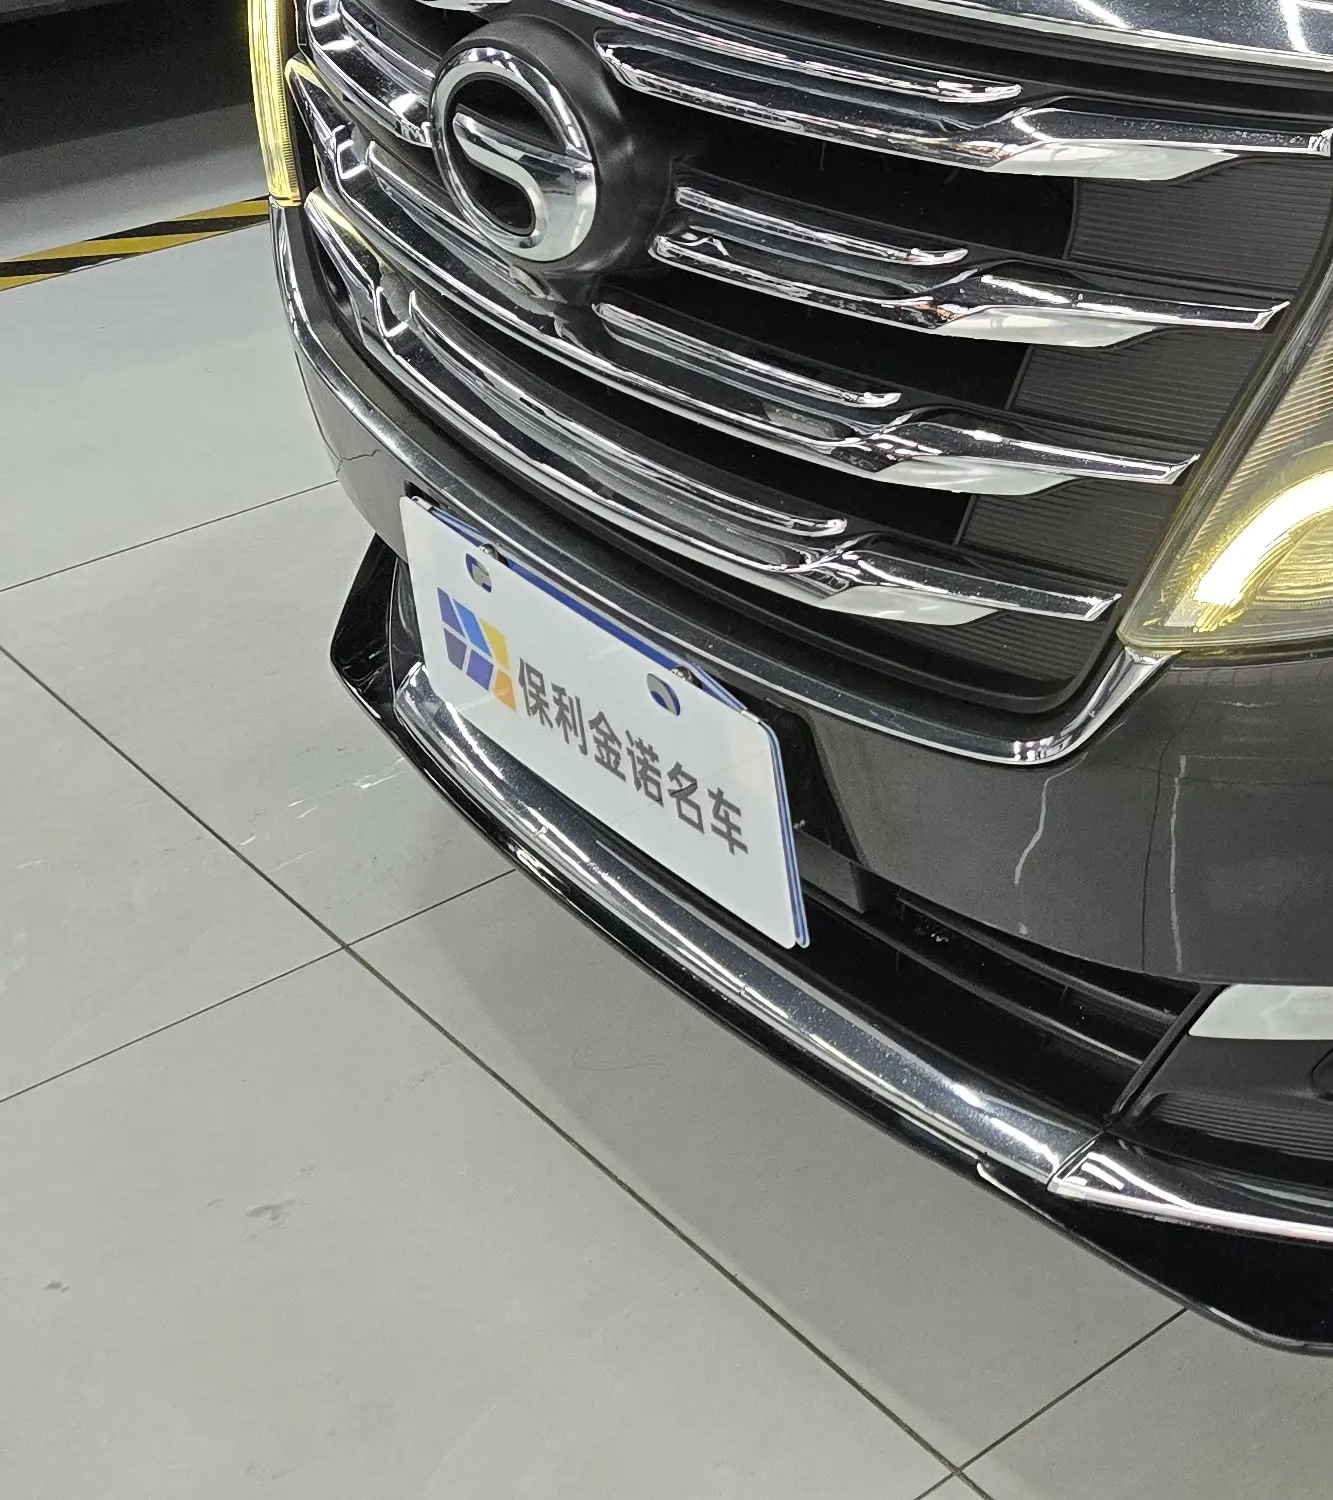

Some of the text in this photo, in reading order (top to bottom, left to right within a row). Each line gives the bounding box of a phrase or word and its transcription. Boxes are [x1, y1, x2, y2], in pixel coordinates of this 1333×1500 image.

[518, 658, 749, 855] 保利金诺名车
